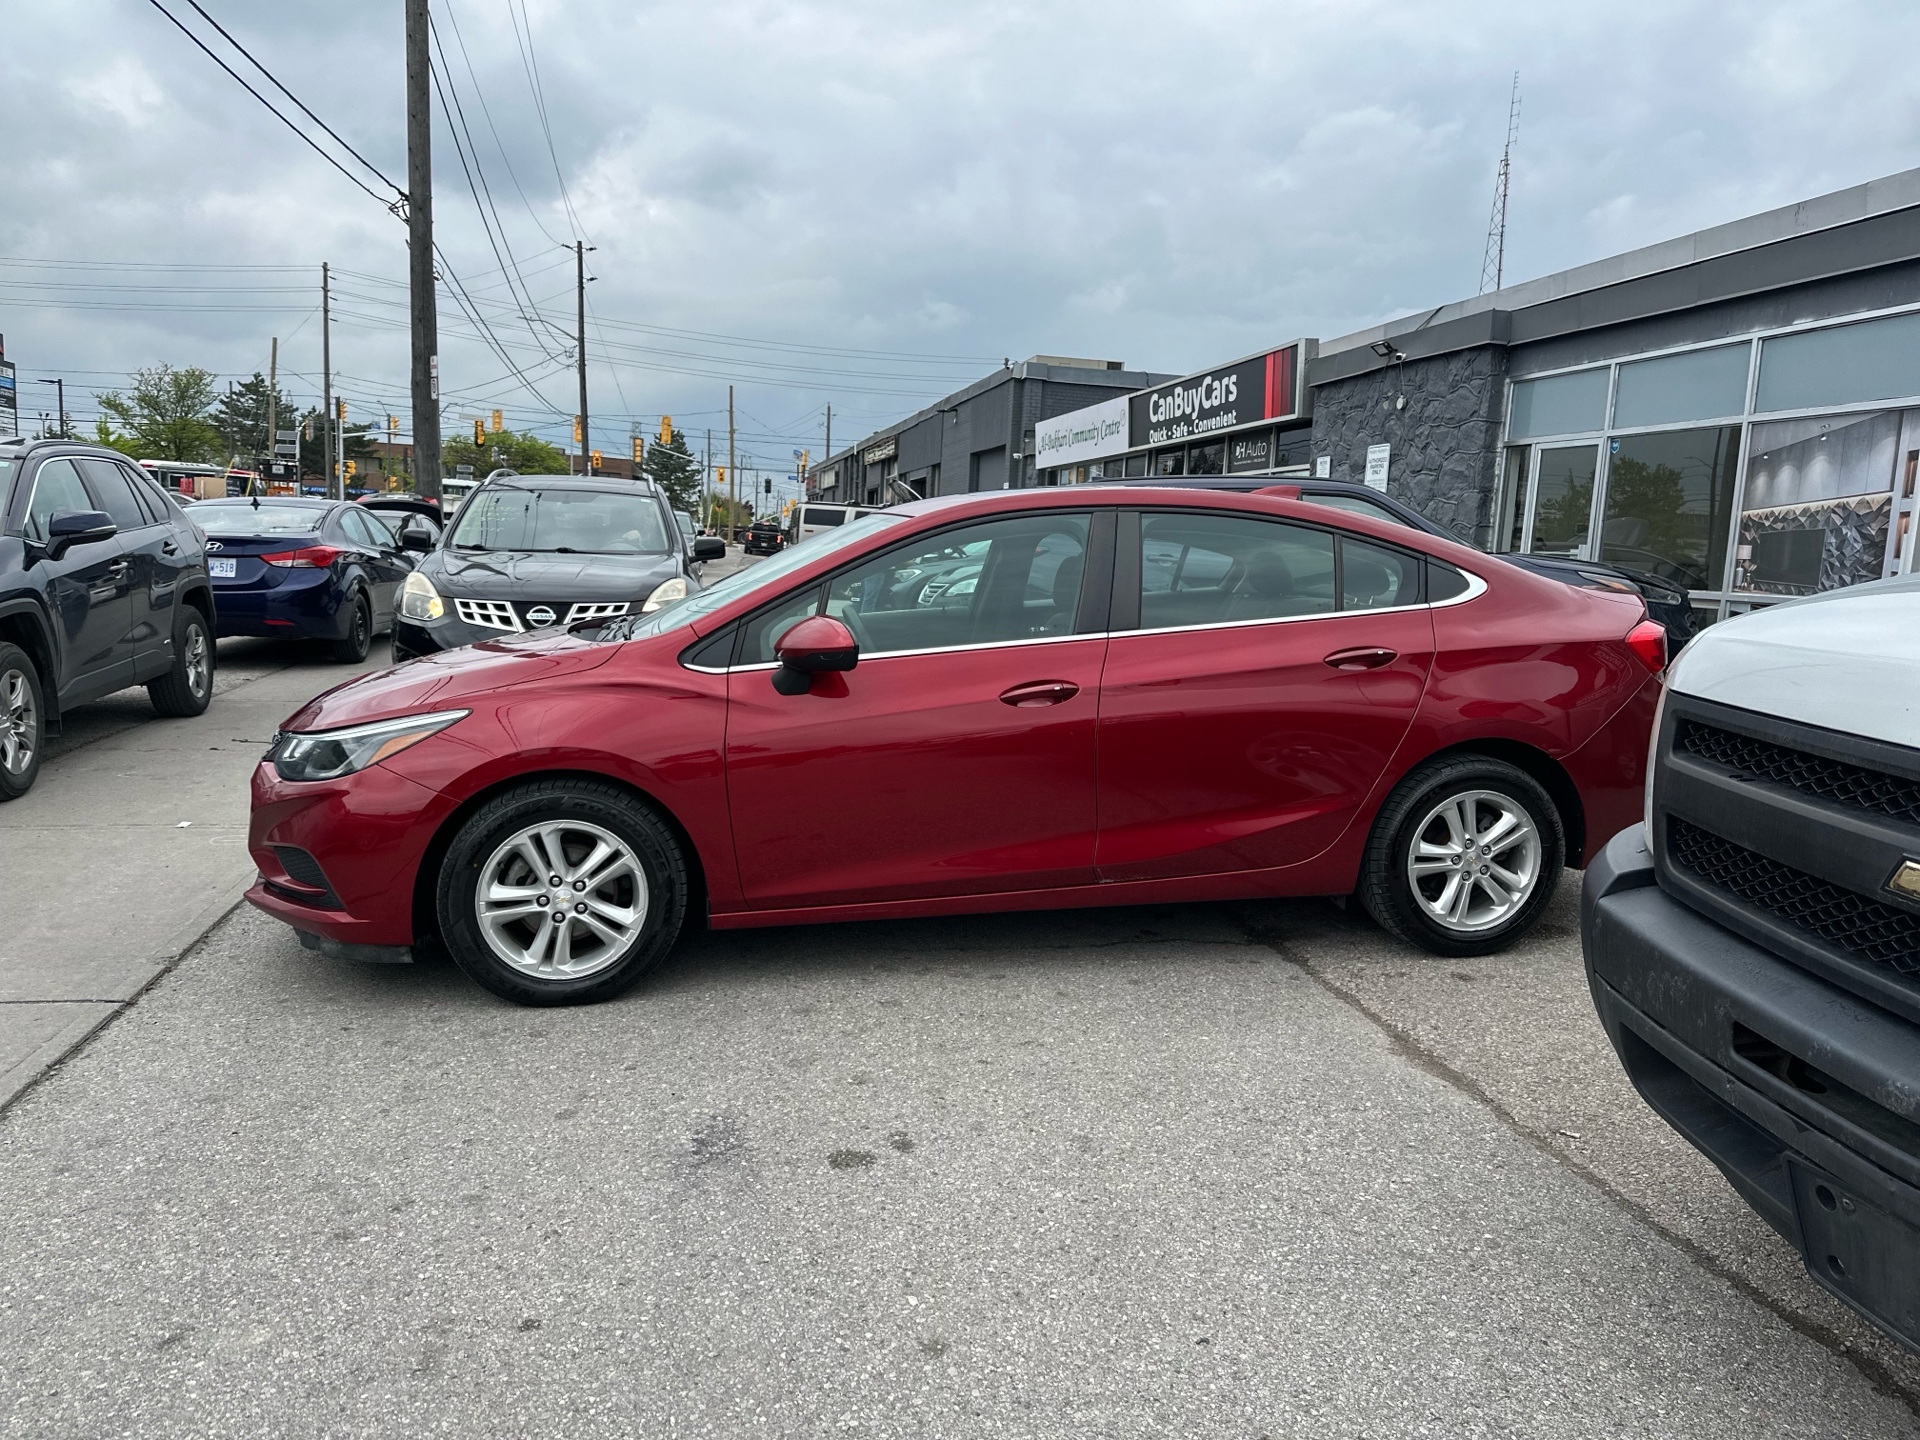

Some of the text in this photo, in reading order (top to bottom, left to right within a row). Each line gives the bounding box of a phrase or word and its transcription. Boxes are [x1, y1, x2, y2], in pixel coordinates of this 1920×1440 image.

[1149, 374, 1237, 423] CanBuyCars
[1068, 422, 1099, 447] Community
[1101, 419, 1121, 440] Centre
[1149, 409, 1236, 444] Quick Safe Convenient
[1246, 440, 1267, 458] Auto
